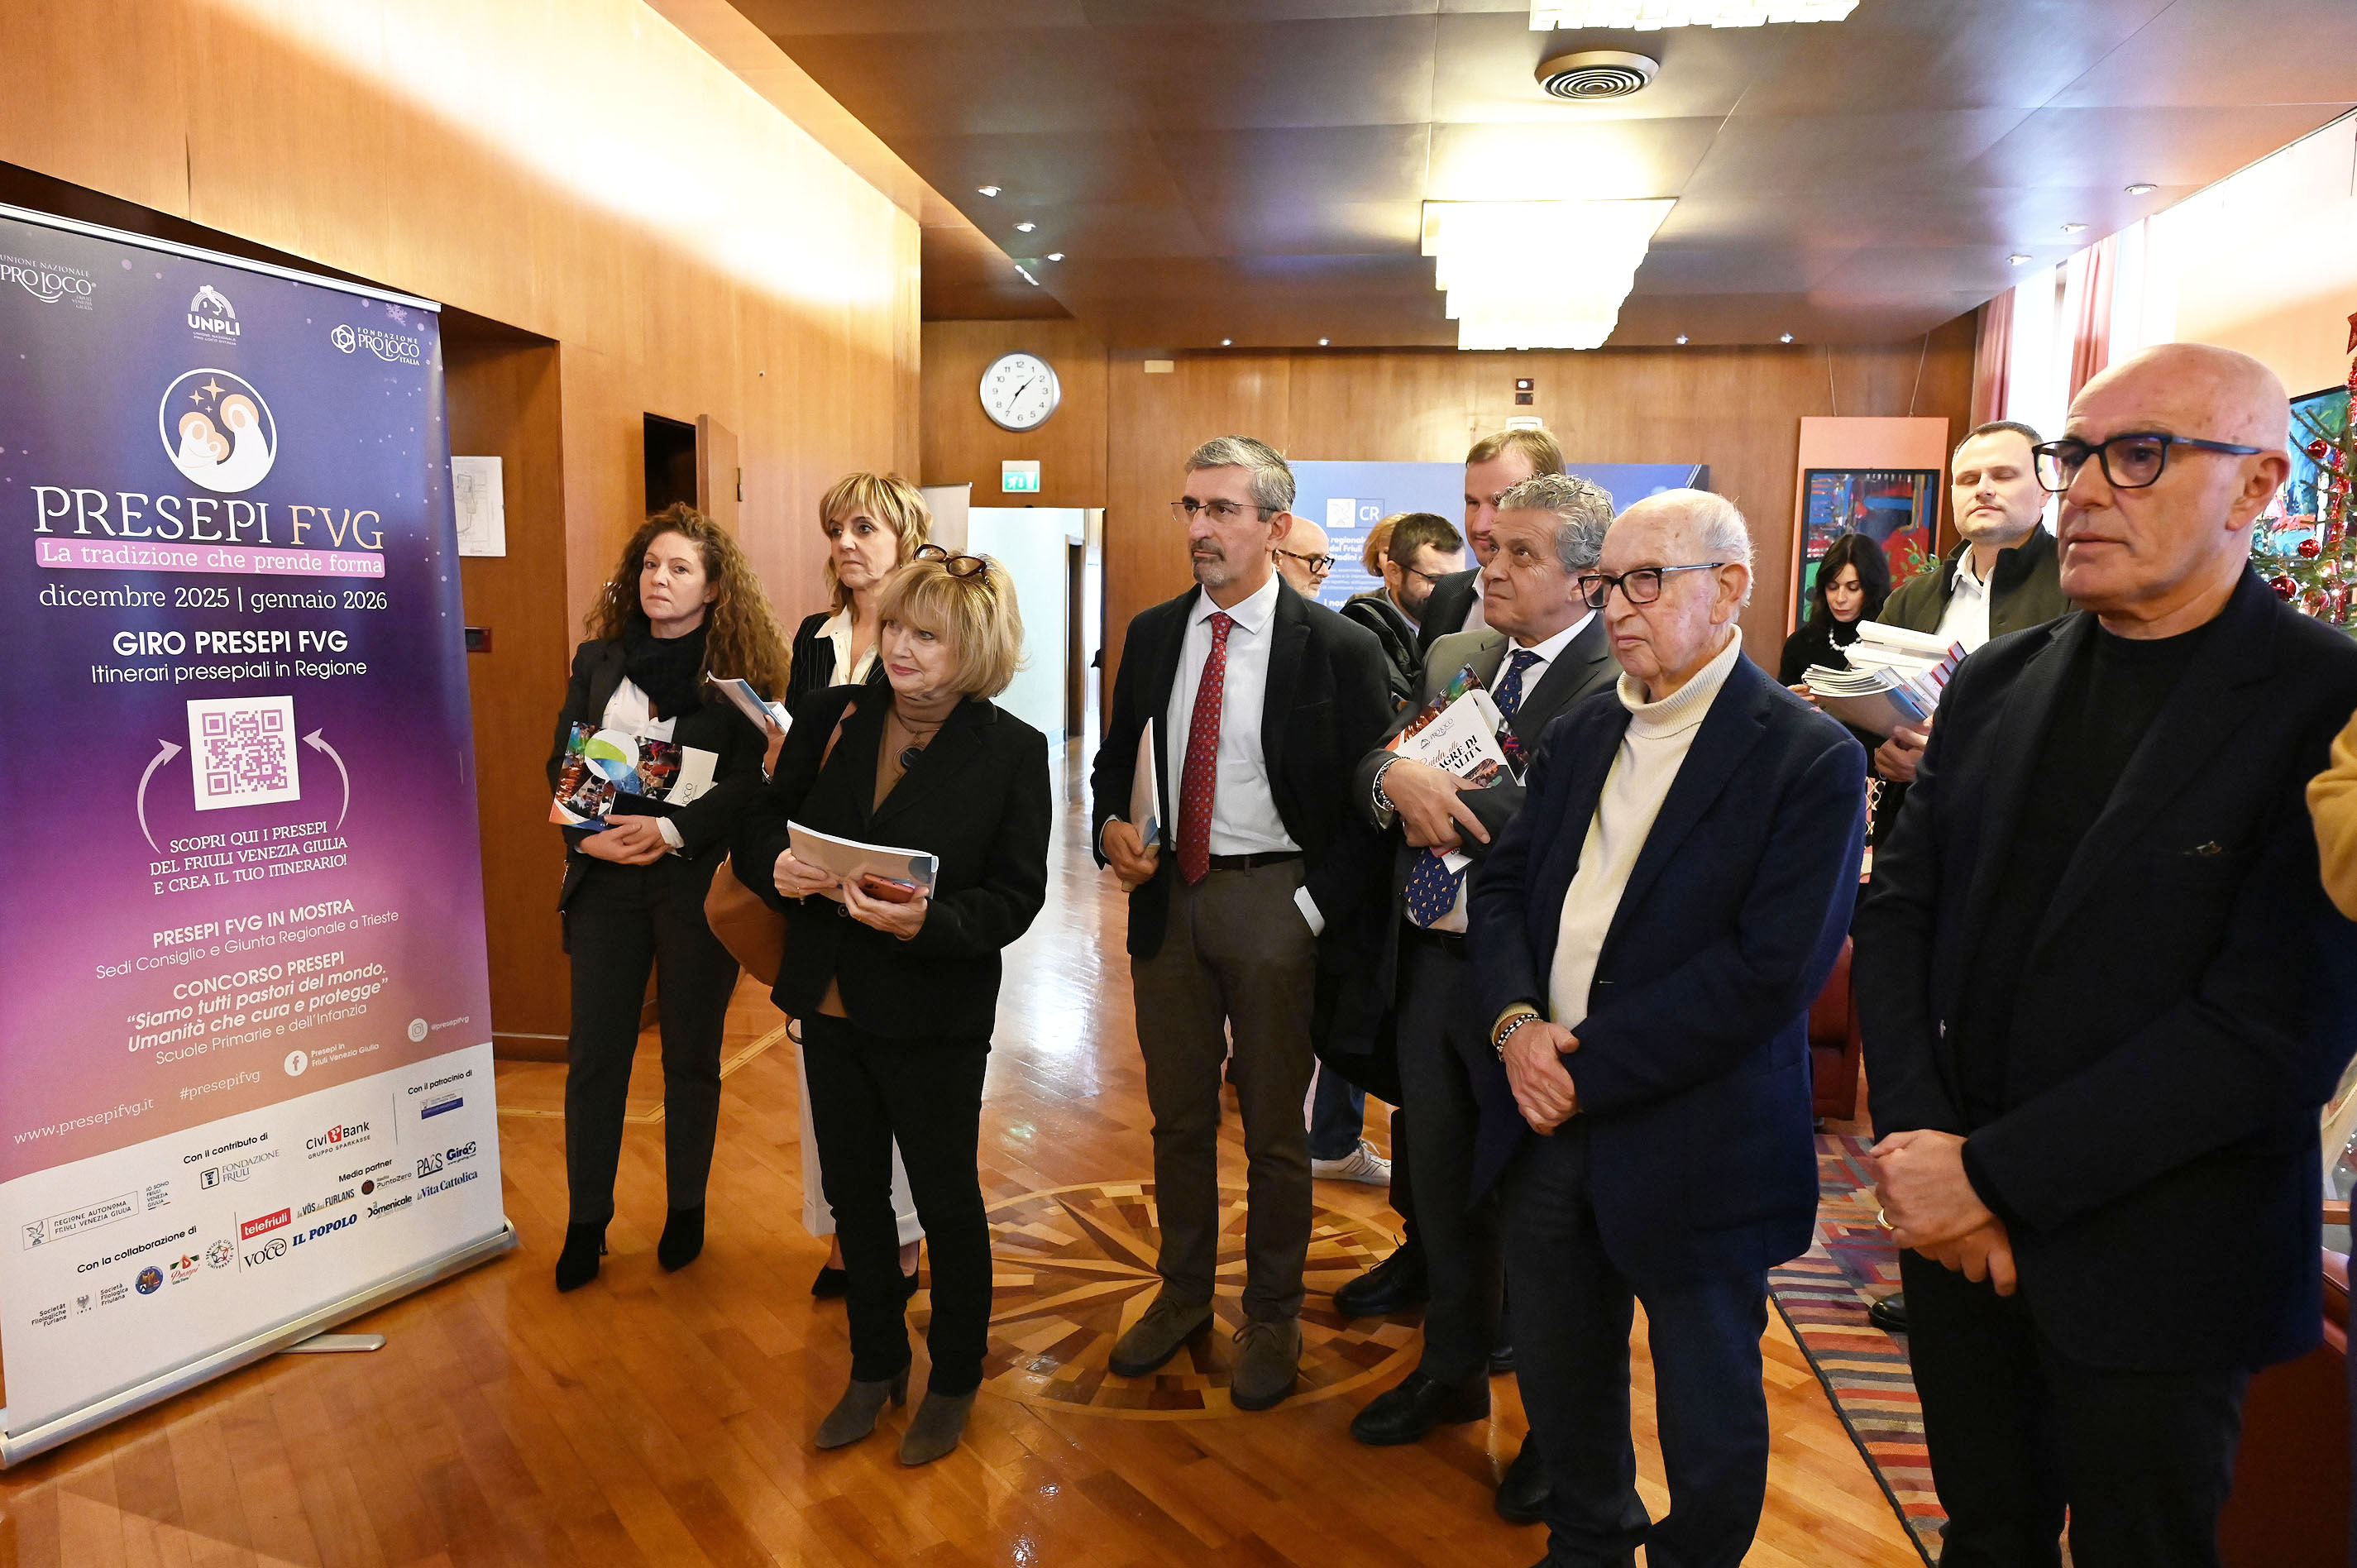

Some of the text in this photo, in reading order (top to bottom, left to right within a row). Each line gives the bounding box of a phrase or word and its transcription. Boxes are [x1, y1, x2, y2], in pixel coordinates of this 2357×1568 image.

[0, 255, 90, 278] UNIONE NAZIONALE
[187, 313, 241, 336] UNPLI
[357, 327, 418, 344] FONDAZIONE
[399, 356, 420, 366] ITALIA
[31, 485, 385, 550] PRESEPI FVG
[1359, 505, 1379, 521] CR
[41, 542, 383, 574] La tradizione che prende forma
[39, 583, 388, 613] dicembre 2025 gennaio 2026
[112, 630, 348, 657] GIRO PRESEPI FVG
[92, 659, 367, 684] Itinerari presepiali in Regione
[1437, 745, 1465, 768] AGRE
[170, 820, 327, 853] SCOPRI QUI I PRESEPI
[150, 837, 348, 877] DEL FRIULI VENEZIA GIULIA
[154, 854, 347, 895] E CREA IL TUO ITINERARIO!
[153, 898, 354, 949] PRESEPI FVG IN MOSTRA
[96, 910, 399, 979] Sedi Consiglio e Giunta Regionale a Trieste
[173, 950, 346, 1000] CONCORSO PRESEPI
[198, 995, 233, 1016] tutti
[236, 982, 294, 1011] pastori
[299, 973, 323, 992] del
[327, 962, 386, 987] mondo.
[128, 1021, 207, 1053] Umanità
[210, 1013, 246, 1033] che
[251, 1006, 289, 1024] cura
[294, 1001, 305, 1012] e
[156, 1043, 208, 1065] Scuole
[213, 1029, 271, 1052] Primarie
[275, 1024, 285, 1035] e
[311, 1044, 337, 1057] Presepi
[312, 1043, 380, 1068] Friuli Venezia Giulia
[179, 1070, 261, 1101] #presepifvg
[408, 1085, 423, 1095] Con
[429, 1073, 465, 1090] patrocinio
[466, 1069, 472, 1078] di
[13, 1097, 155, 1145] www.presepifvg.it
[183, 1132, 269, 1164] Con il contributo di
[308, 1135, 371, 1159] GRUPPO SPARKASSE
[222, 1149, 280, 1174] FONDAZIONE
[338, 1159, 393, 1183] Media partner
[153, 1181, 170, 1190] SONO
[222, 1167, 251, 1183] FRIULI
[421, 1186, 439, 1198] Vita
[440, 1171, 478, 1191] Cattolica
[146, 1193, 168, 1202] VENEZIA
[147, 1199, 164, 1208] GIULIA
[325, 1188, 355, 1207] FURLANS
[54, 1200, 127, 1227] REGIONE AUTONOMA
[55, 1207, 131, 1235] FRIULI VENEZIA GIULIA
[244, 1212, 288, 1236] telefriuli
[293, 1213, 357, 1246] IL POPOLO
[77, 1226, 197, 1274] Con la collaborazione di
[100, 1287, 128, 1301] Filologica
[101, 1294, 126, 1307] Friulana
[43, 1315, 67, 1327] Furlane
